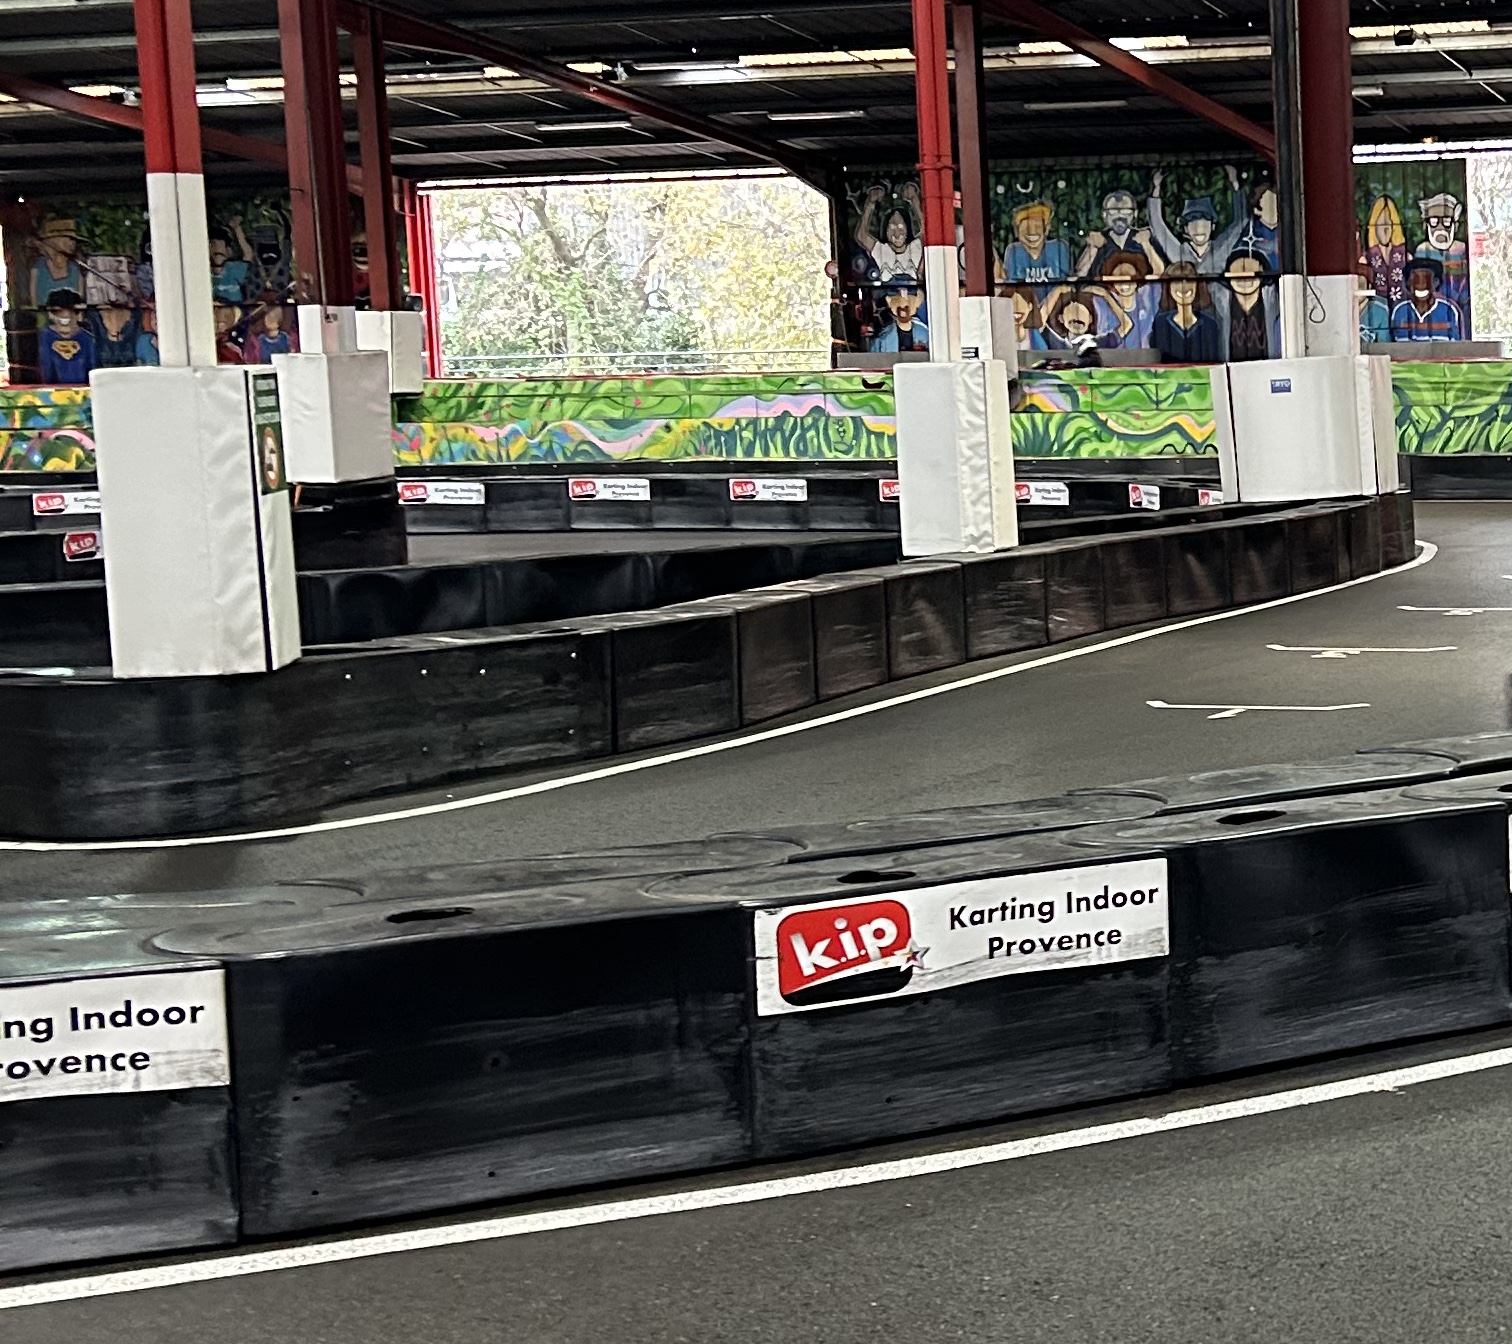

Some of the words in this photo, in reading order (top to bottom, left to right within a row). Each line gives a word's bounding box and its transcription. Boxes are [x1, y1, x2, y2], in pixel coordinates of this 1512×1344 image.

[949, 896, 1055, 931] Karting
[1066, 885, 1159, 914] Indoor
[988, 928, 1122, 959] Provence
[70, 1000, 205, 1031] Indoor
